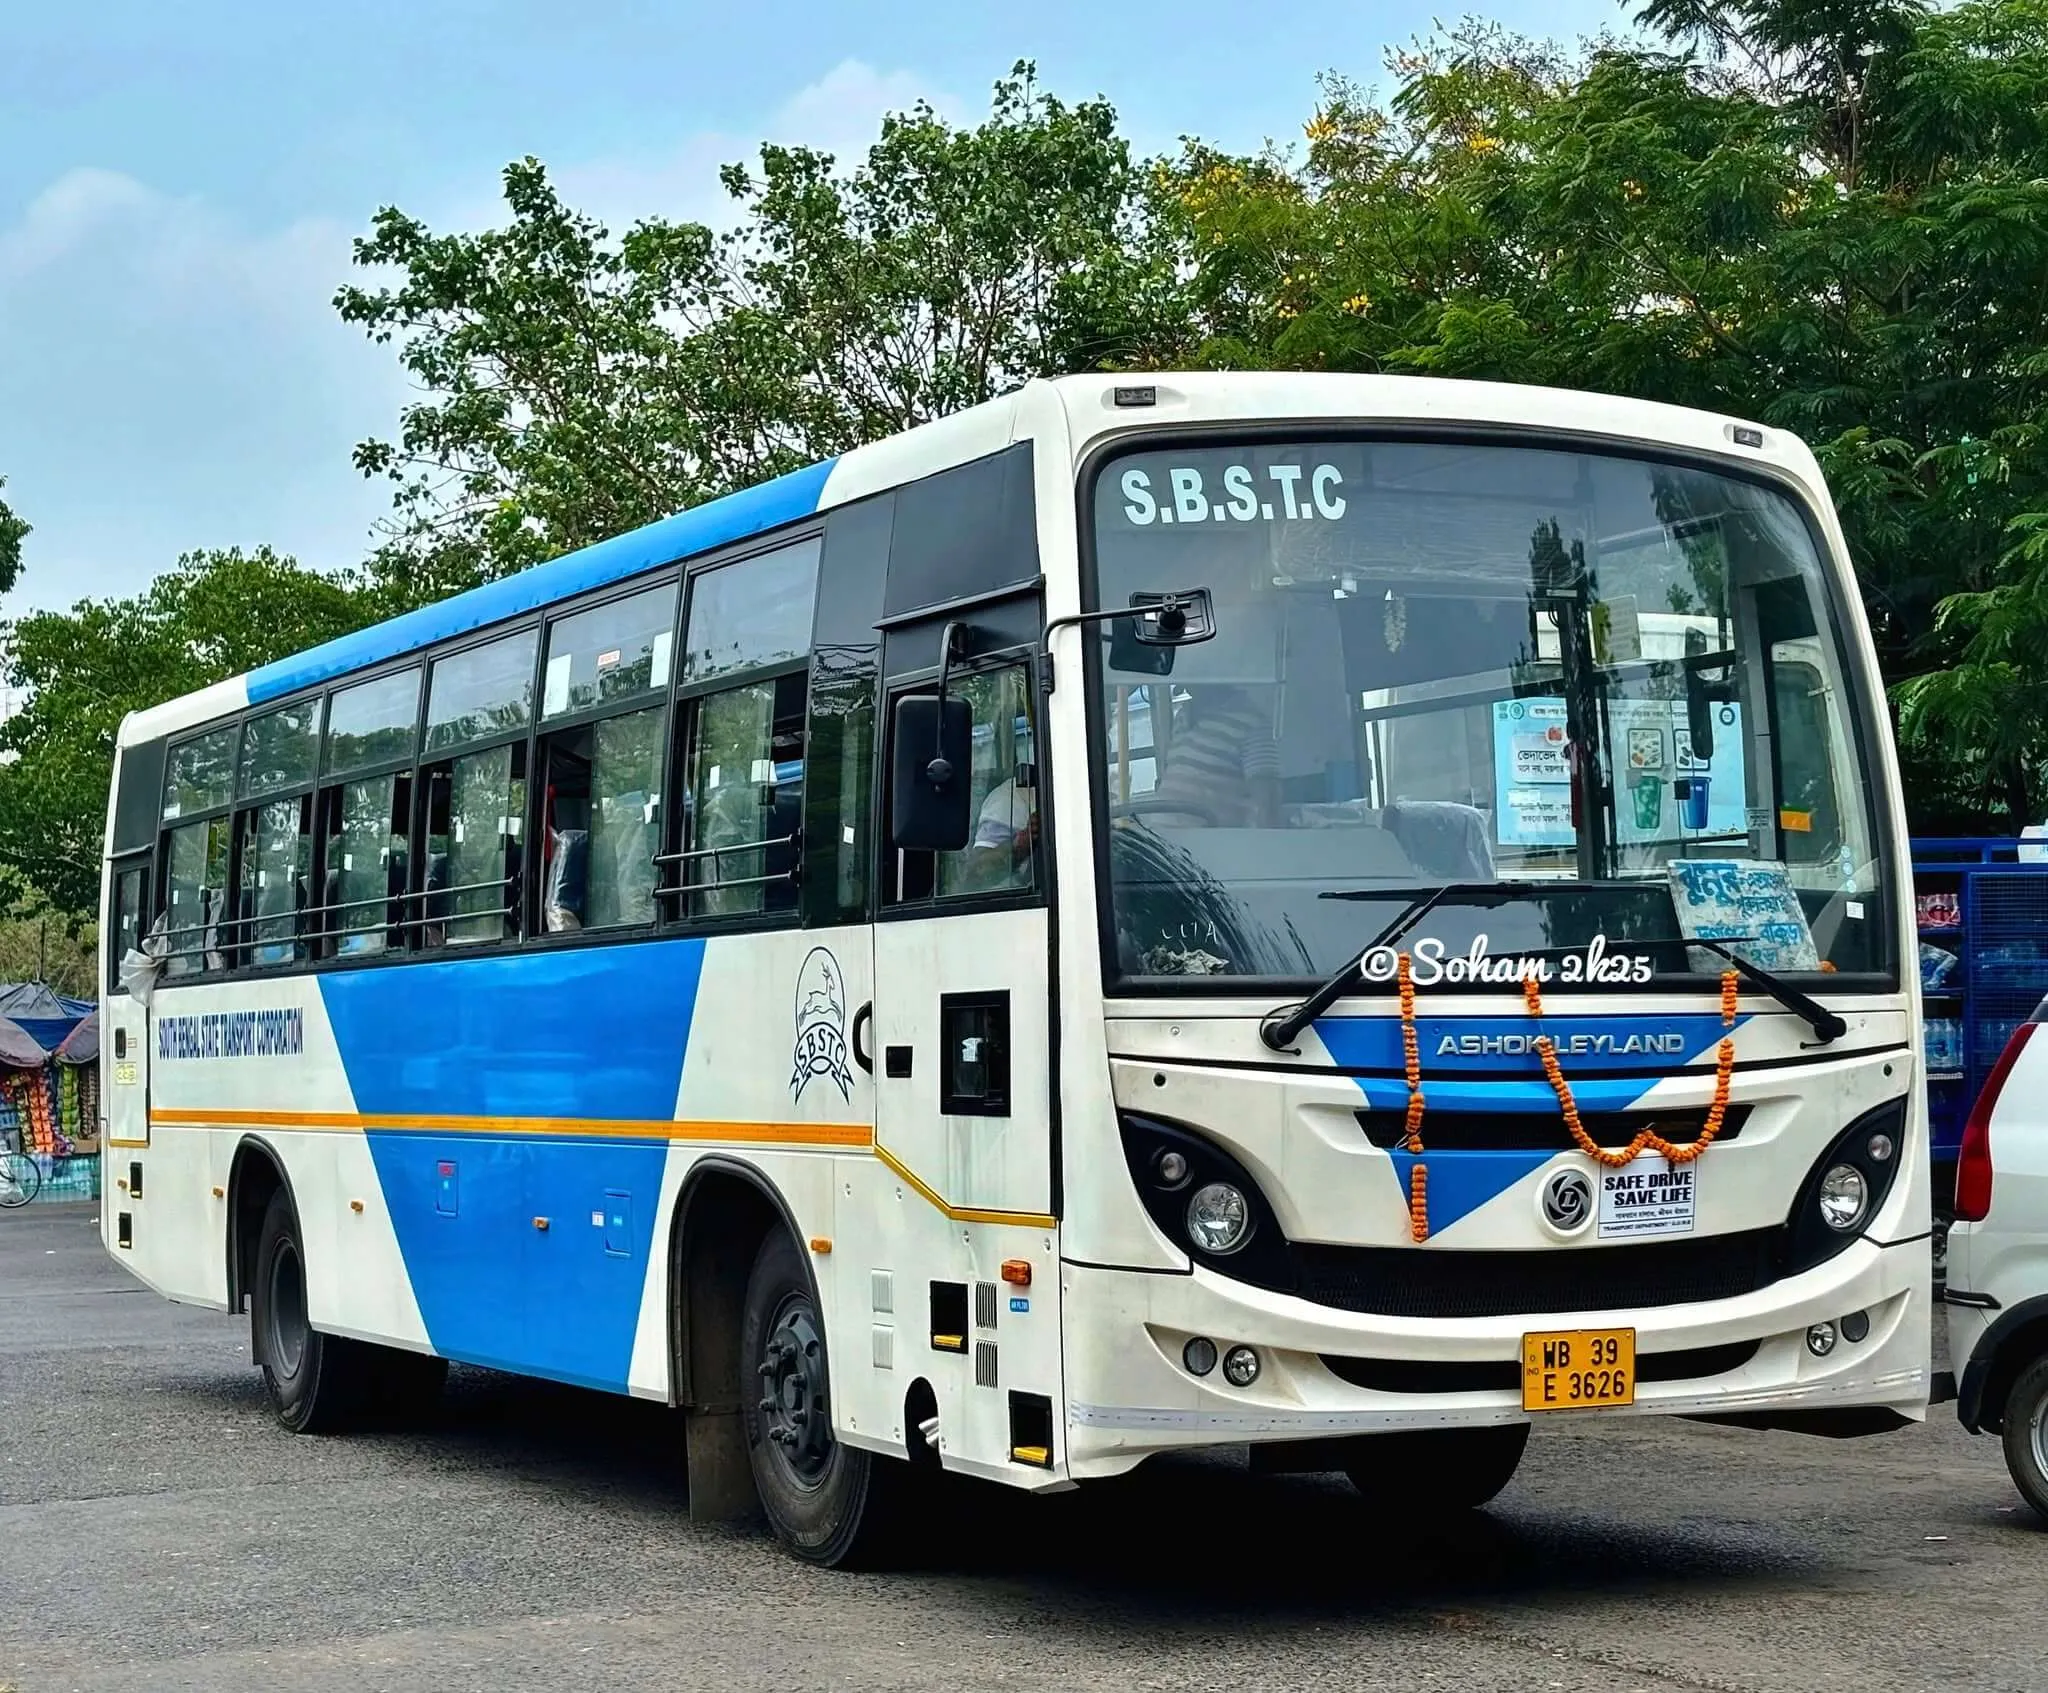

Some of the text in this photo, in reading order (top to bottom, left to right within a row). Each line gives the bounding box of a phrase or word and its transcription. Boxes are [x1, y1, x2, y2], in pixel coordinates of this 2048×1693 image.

[1120, 464, 1347, 525] S.B.S.T.C
[158, 1007, 304, 1059] SOUTH BENGAL STATE TRANSPORT CORPORATION
[797, 1028, 844, 1069] SBSTC
[1557, 1033, 1686, 1055] LEYLAND
[1604, 1171, 1693, 1191] SAFE DRIVE
[1614, 1187, 1692, 1206] SAVE LIFE
[1543, 1337, 1618, 1369] WB 39
[1543, 1369, 1626, 1402] E 3626
